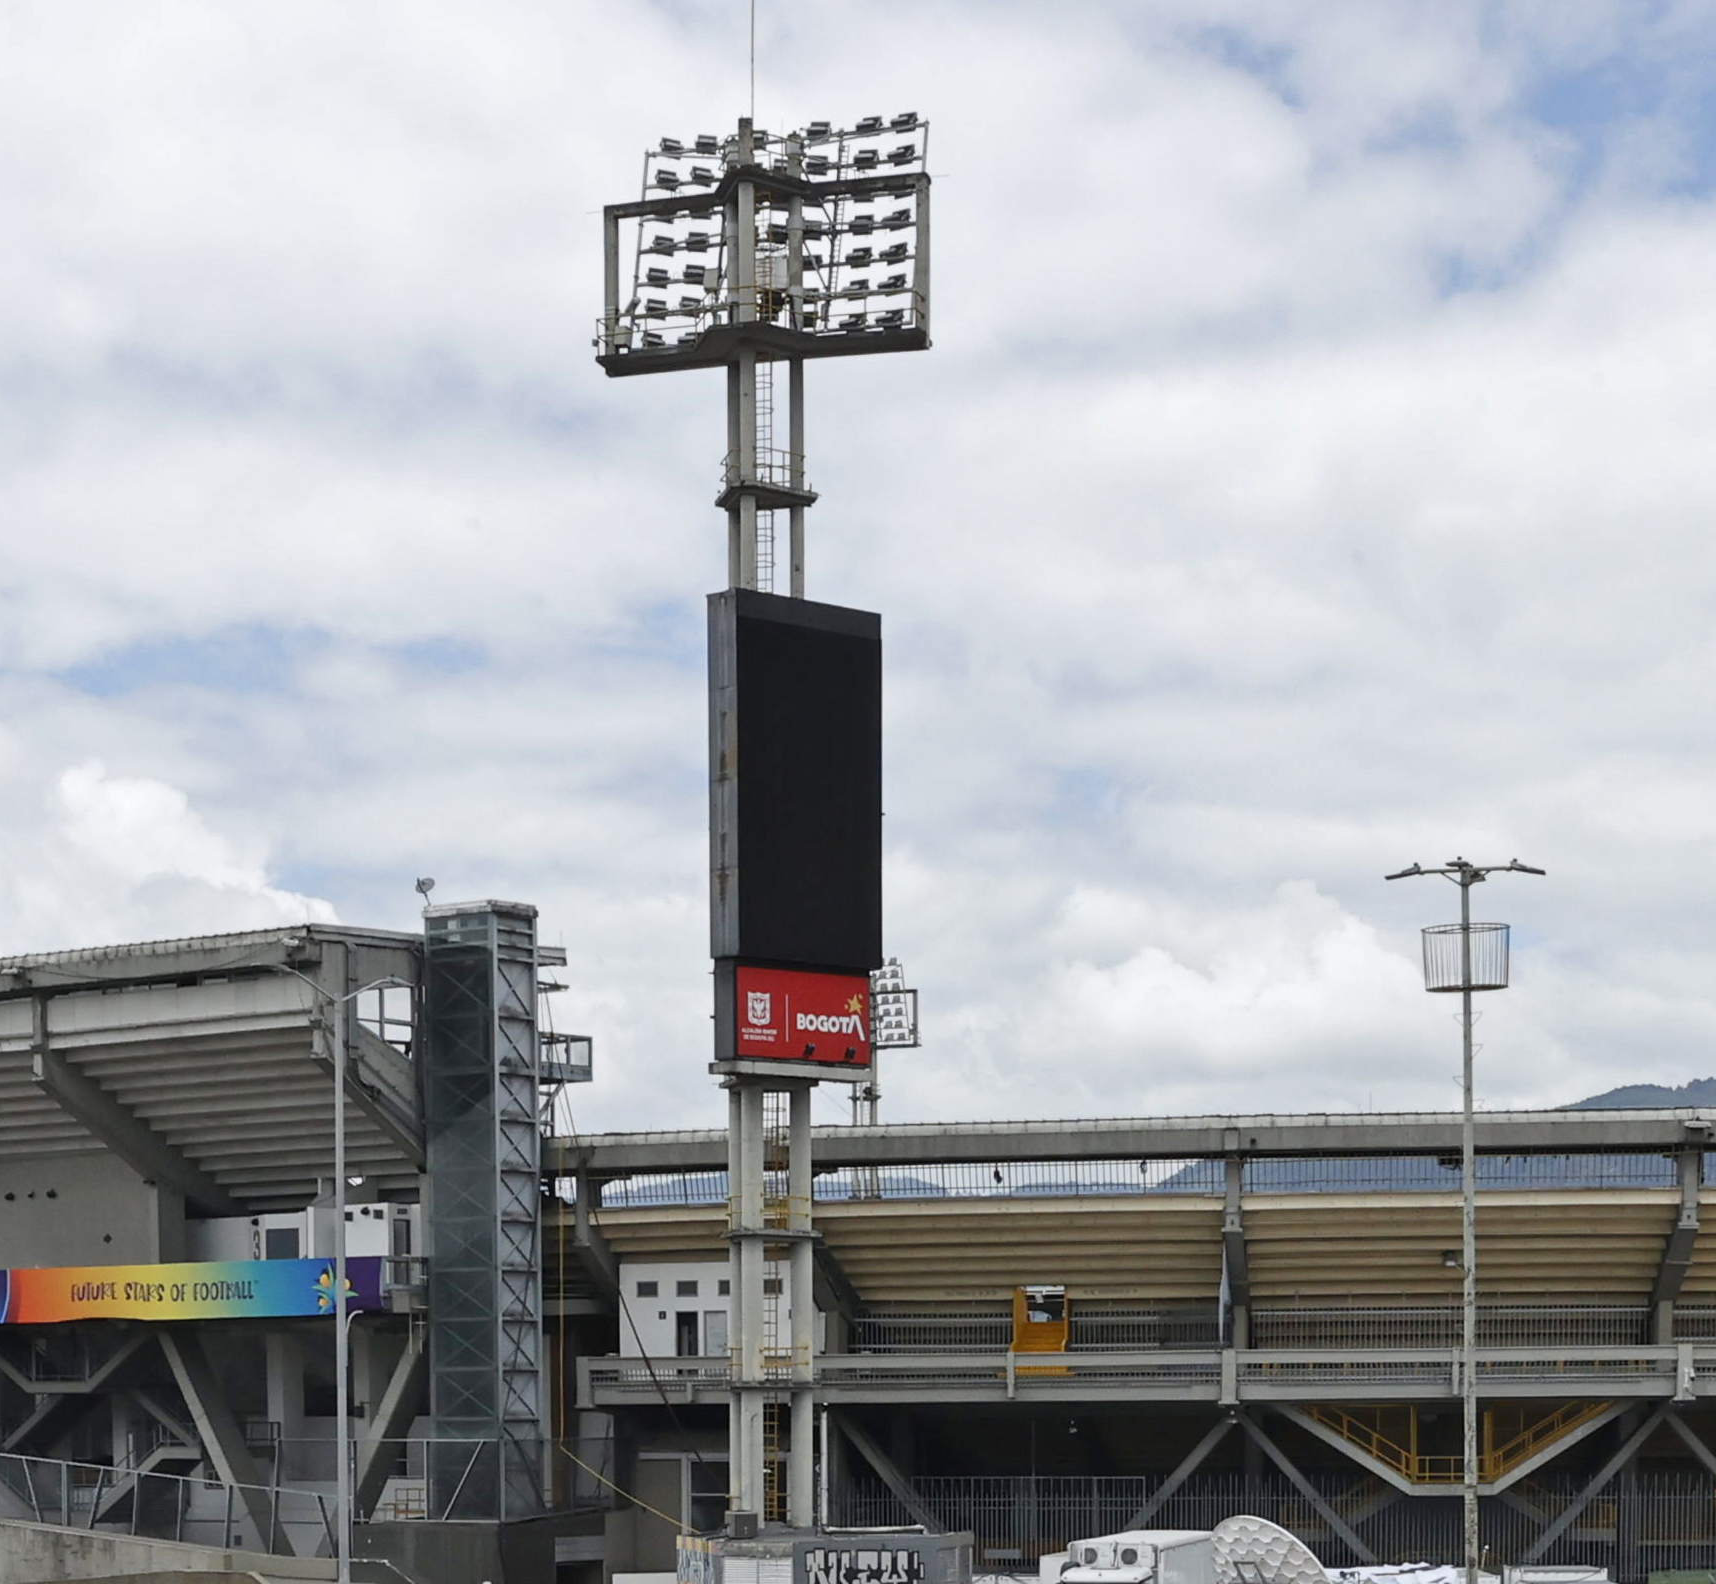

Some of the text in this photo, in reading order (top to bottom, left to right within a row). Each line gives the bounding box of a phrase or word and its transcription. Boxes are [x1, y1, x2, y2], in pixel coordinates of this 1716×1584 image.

[71, 1282, 117, 1302] FUTURE
[125, 1282, 165, 1302] STARS
[170, 1282, 188, 1302] OF
